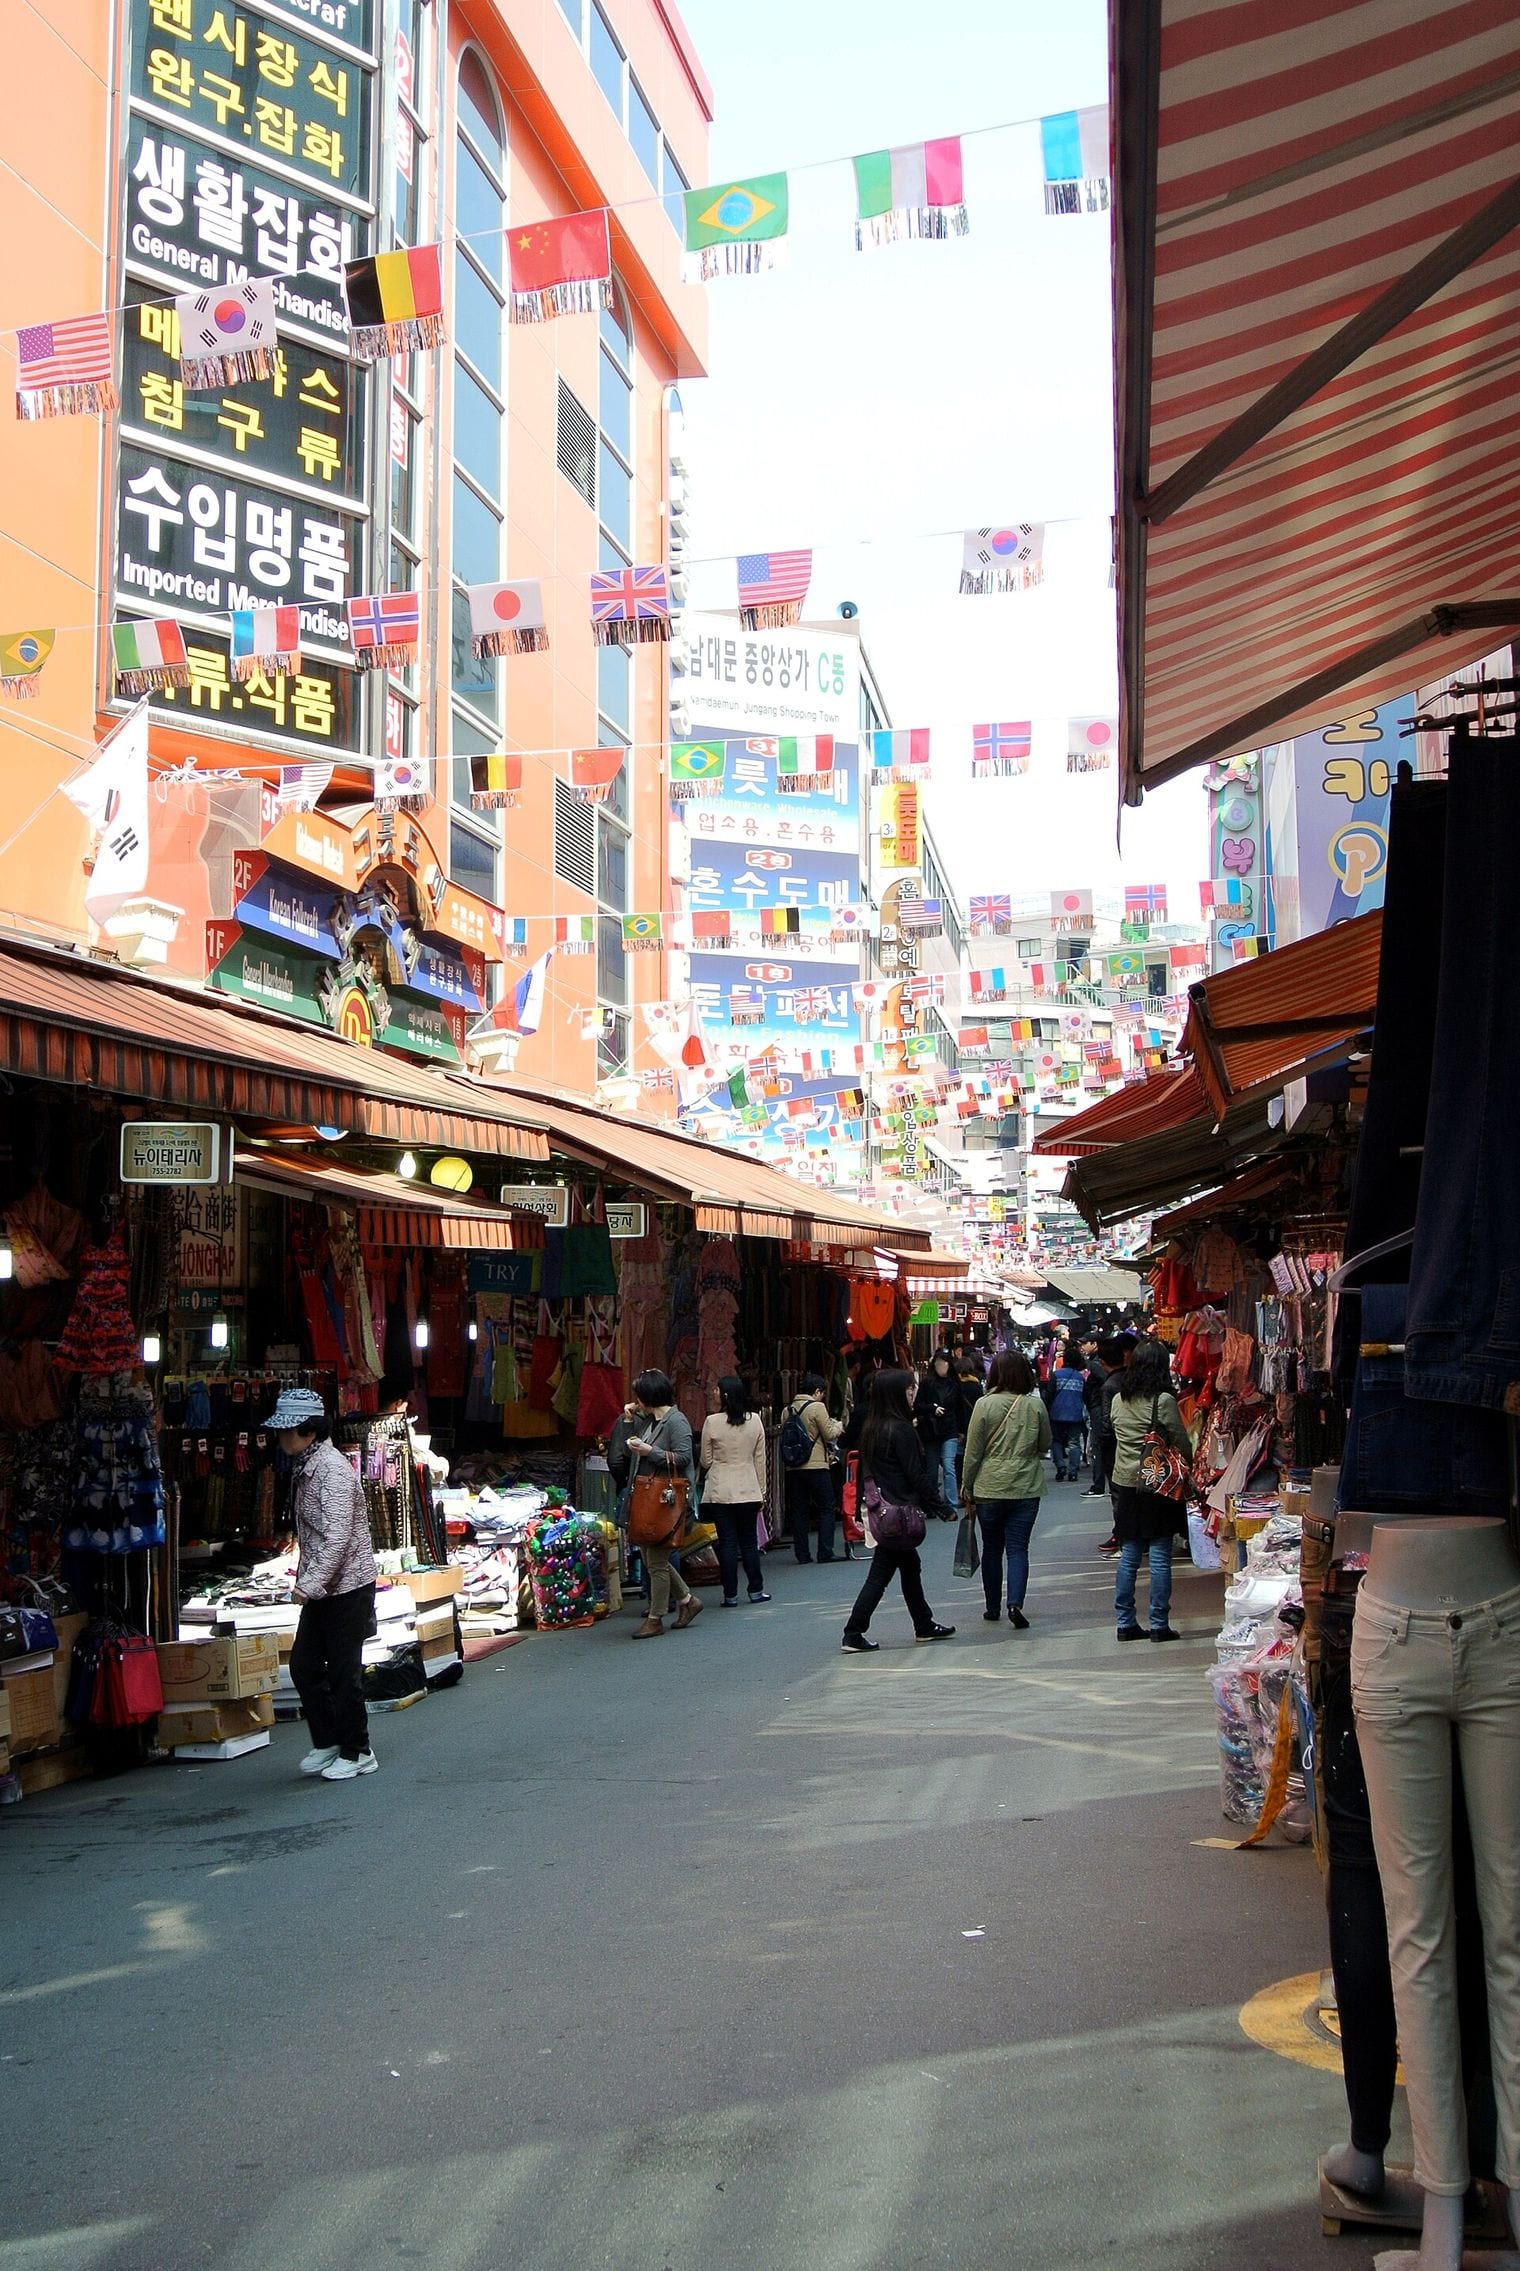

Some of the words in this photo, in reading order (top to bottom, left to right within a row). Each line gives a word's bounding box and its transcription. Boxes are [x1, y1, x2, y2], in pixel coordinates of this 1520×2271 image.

[133, 136, 351, 297] 생활잡화
[132, 223, 218, 281] General
[125, 466, 350, 604] 수입명품
[123, 553, 219, 605] Imported
[745, 643, 809, 691] 중앙상가
[818, 652, 845, 695] C동
[743, 703, 778, 717] Jungang
[779, 705, 817, 722] Shopping
[819, 710, 840, 723] Town
[234, 858, 252, 890] 2F
[687, 866, 849, 910] 혼수도매
[207, 928, 225, 960] 1F
[133, 1148, 202, 1167] 뉴이태리사
[152, 1167, 182, 1175] 755-2782
[485, 1263, 520, 1281] TRY
